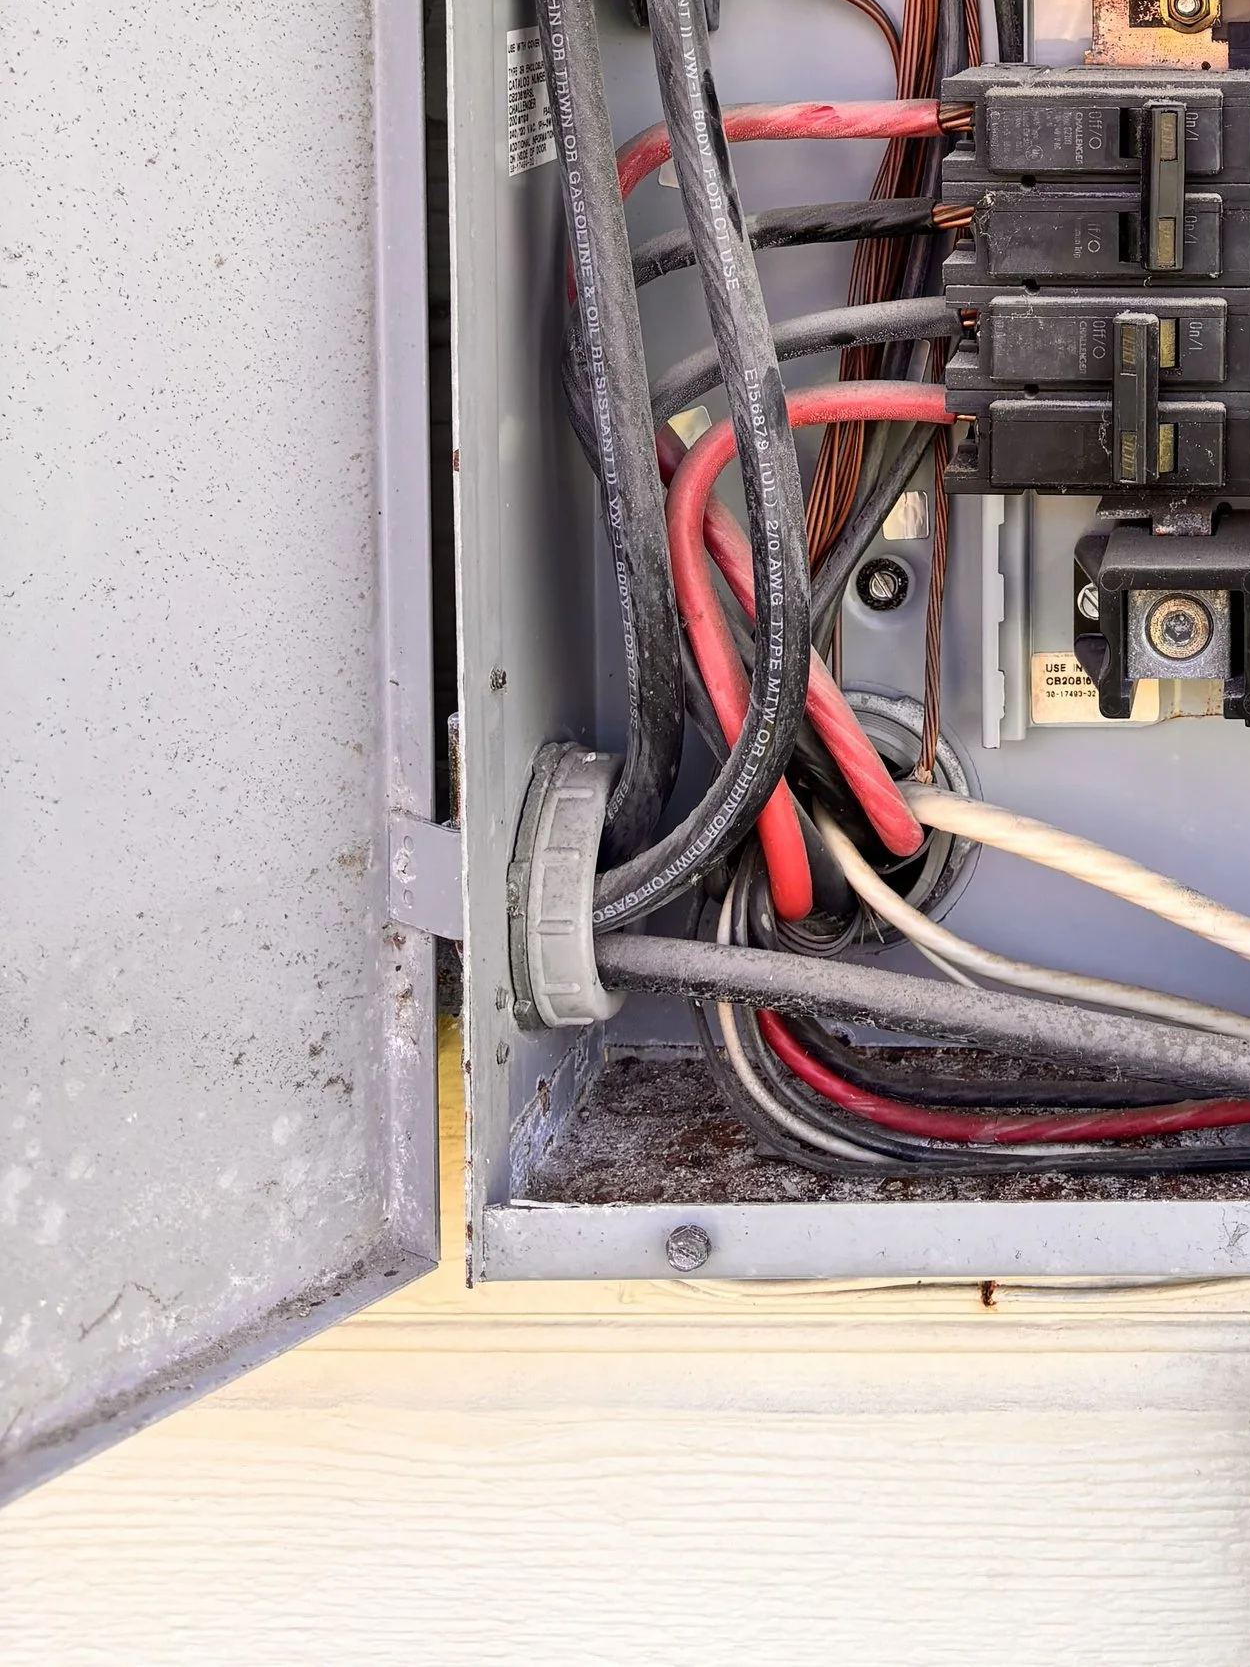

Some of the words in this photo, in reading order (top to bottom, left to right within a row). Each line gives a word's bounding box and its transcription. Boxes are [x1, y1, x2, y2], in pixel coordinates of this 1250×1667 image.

[551, 33, 566, 61] OR
[554, 69, 575, 129] THWN
[564, 135, 579, 163] OR
[569, 172, 595, 275] GASOLINE
[703, 167, 722, 210] FOR
[719, 247, 740, 290] USE
[592, 346, 616, 465] RESISTANT
[743, 369, 769, 451] E156879
[765, 519, 780, 551] 2/0
[768, 557, 783, 606] AWG
[768, 616, 784, 672] TYPE
[1045, 663, 1066, 673] USE
[1073, 663, 1083, 673] IN
[763, 677, 780, 725] MTW
[757, 728, 771, 759] OR
[722, 759, 760, 811] THHN
[665, 841, 707, 880] THWN
